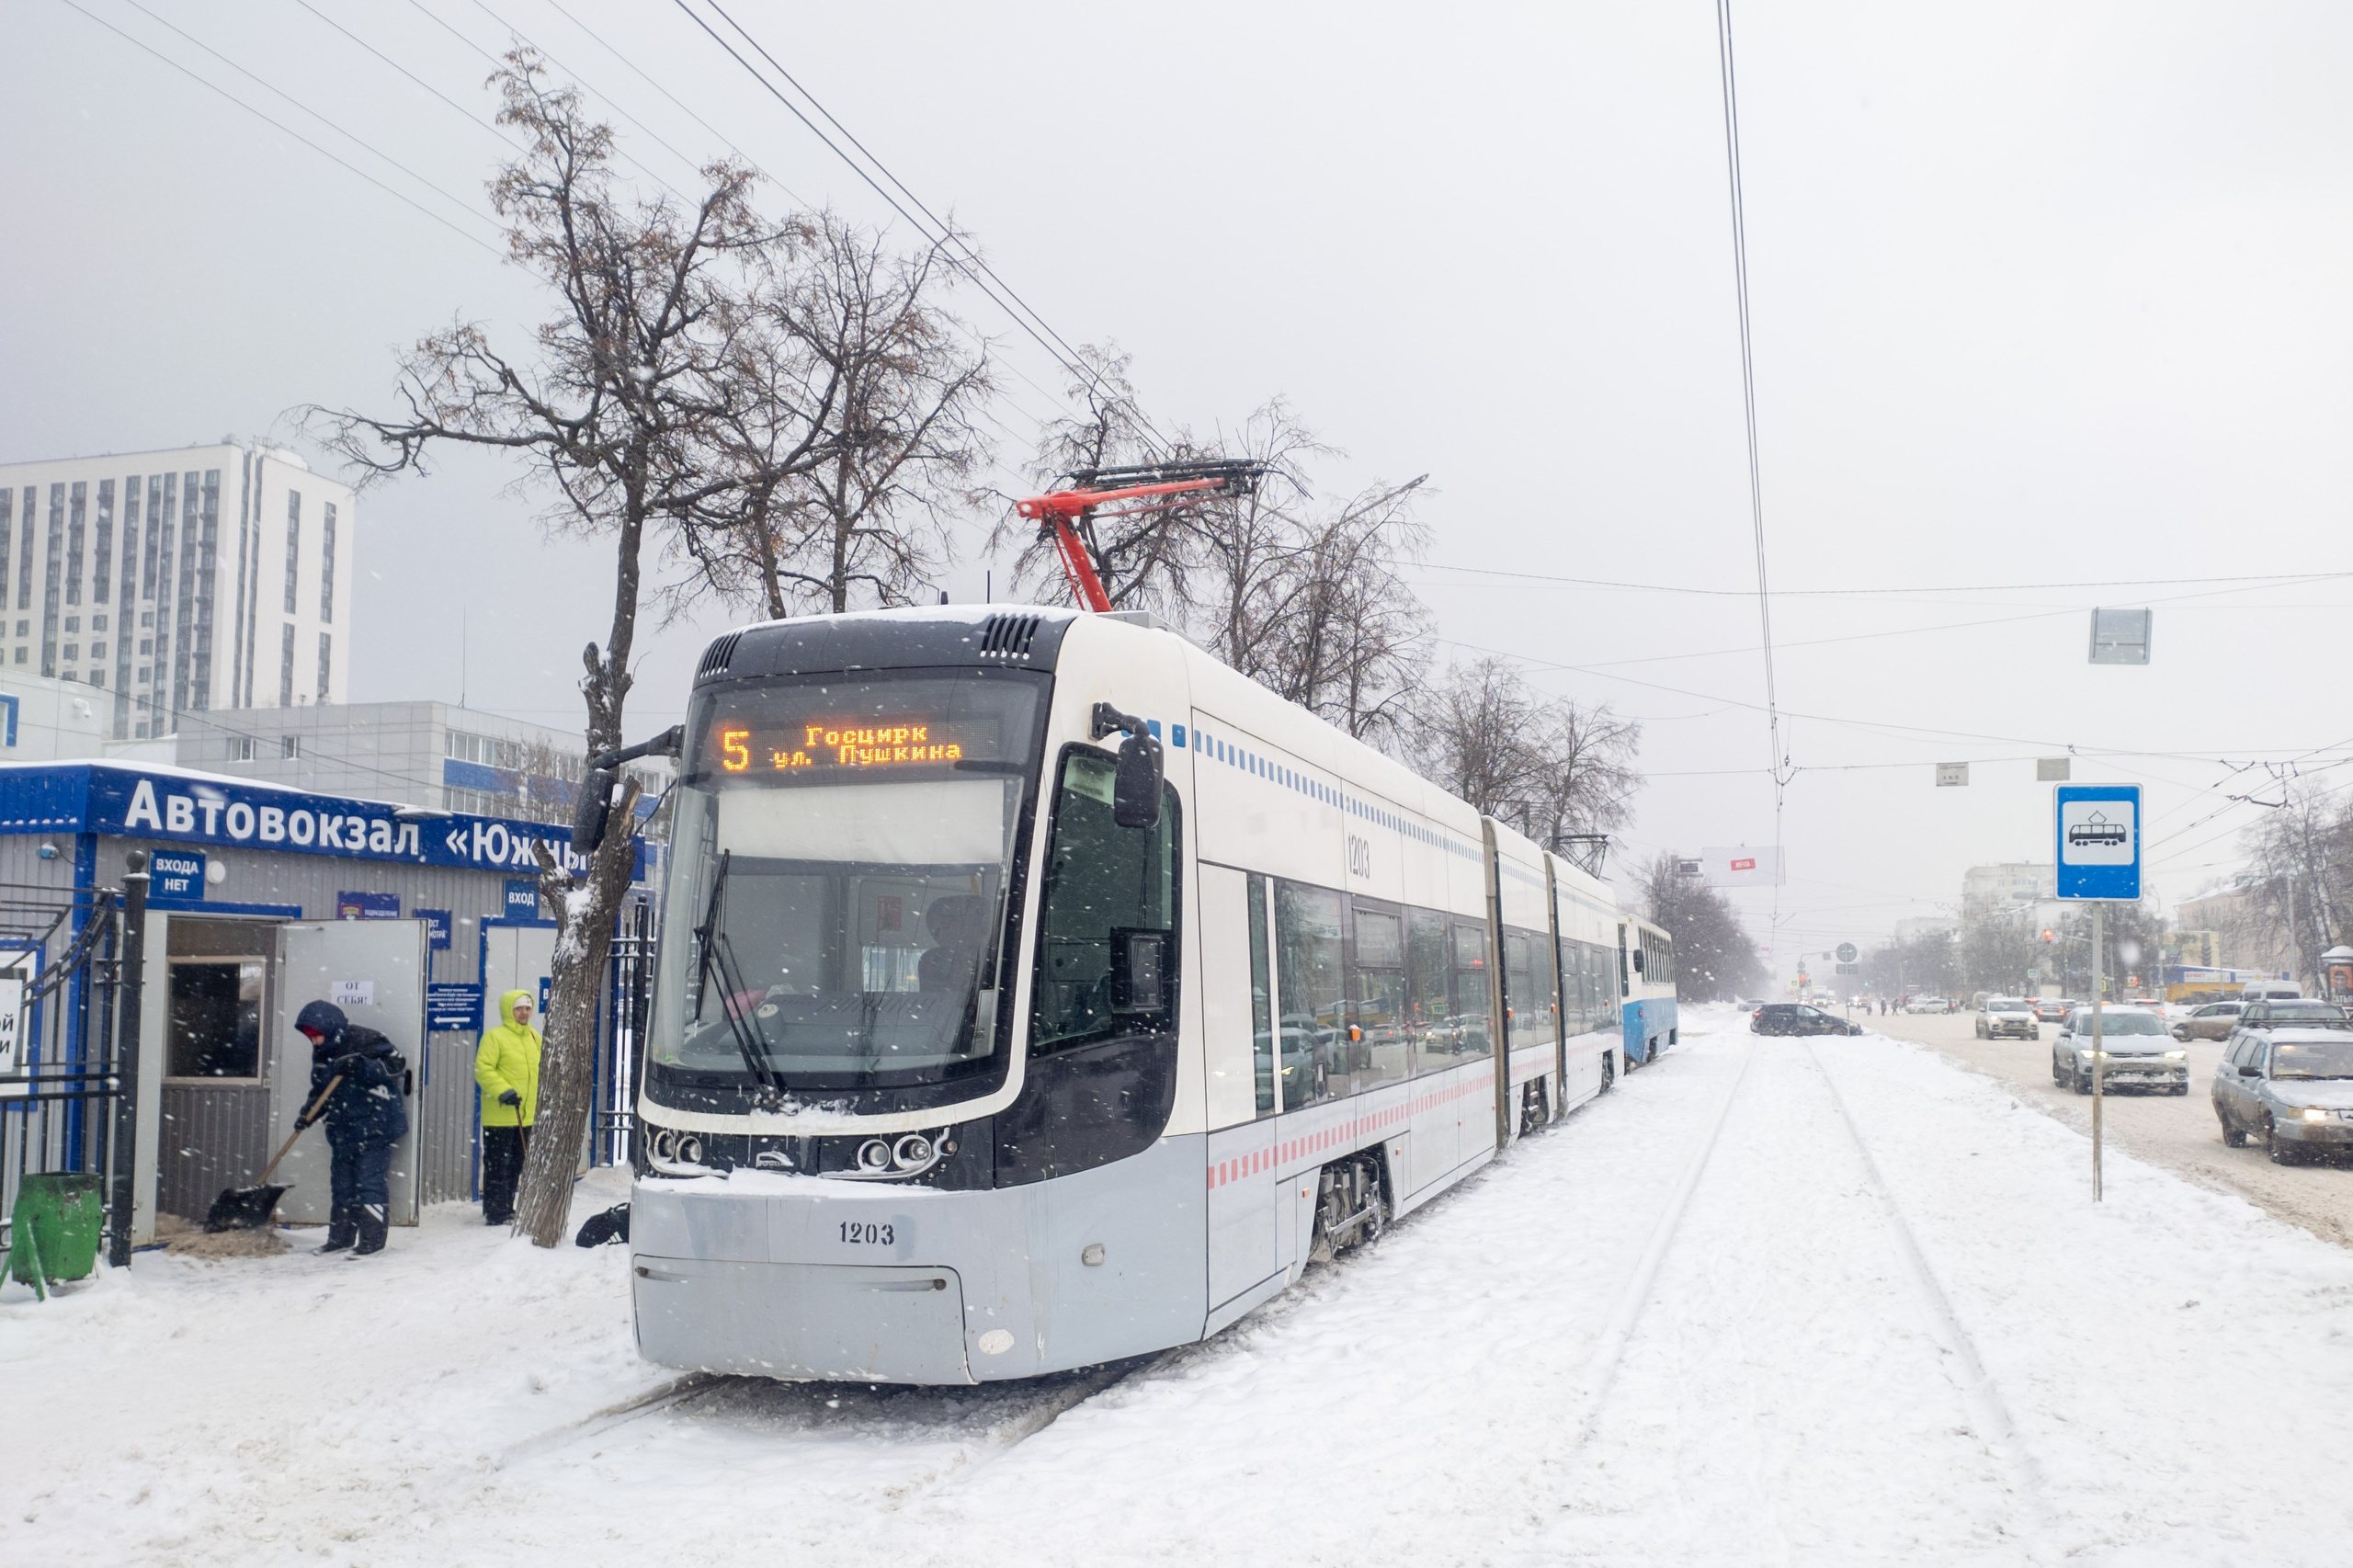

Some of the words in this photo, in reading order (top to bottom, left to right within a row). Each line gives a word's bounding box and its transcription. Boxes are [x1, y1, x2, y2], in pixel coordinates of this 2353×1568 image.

[805, 725, 926, 746] Госцирк
[722, 731, 749, 770] 5
[773, 752, 812, 768] ул.
[840, 744, 961, 765] Пушкина
[124, 779, 419, 856] Автовокзал
[445, 822, 586, 870] «Южны
[1348, 831, 1370, 880] 1203
[156, 858, 199, 874] ВХОДА
[165, 879, 188, 892] НЕТ
[508, 892, 535, 907] ВХОД
[429, 919, 439, 927] ОСТ
[346, 981, 360, 990] ОТ
[336, 995, 368, 1005] СЕБЯ!
[840, 1221, 895, 1245] 1203
